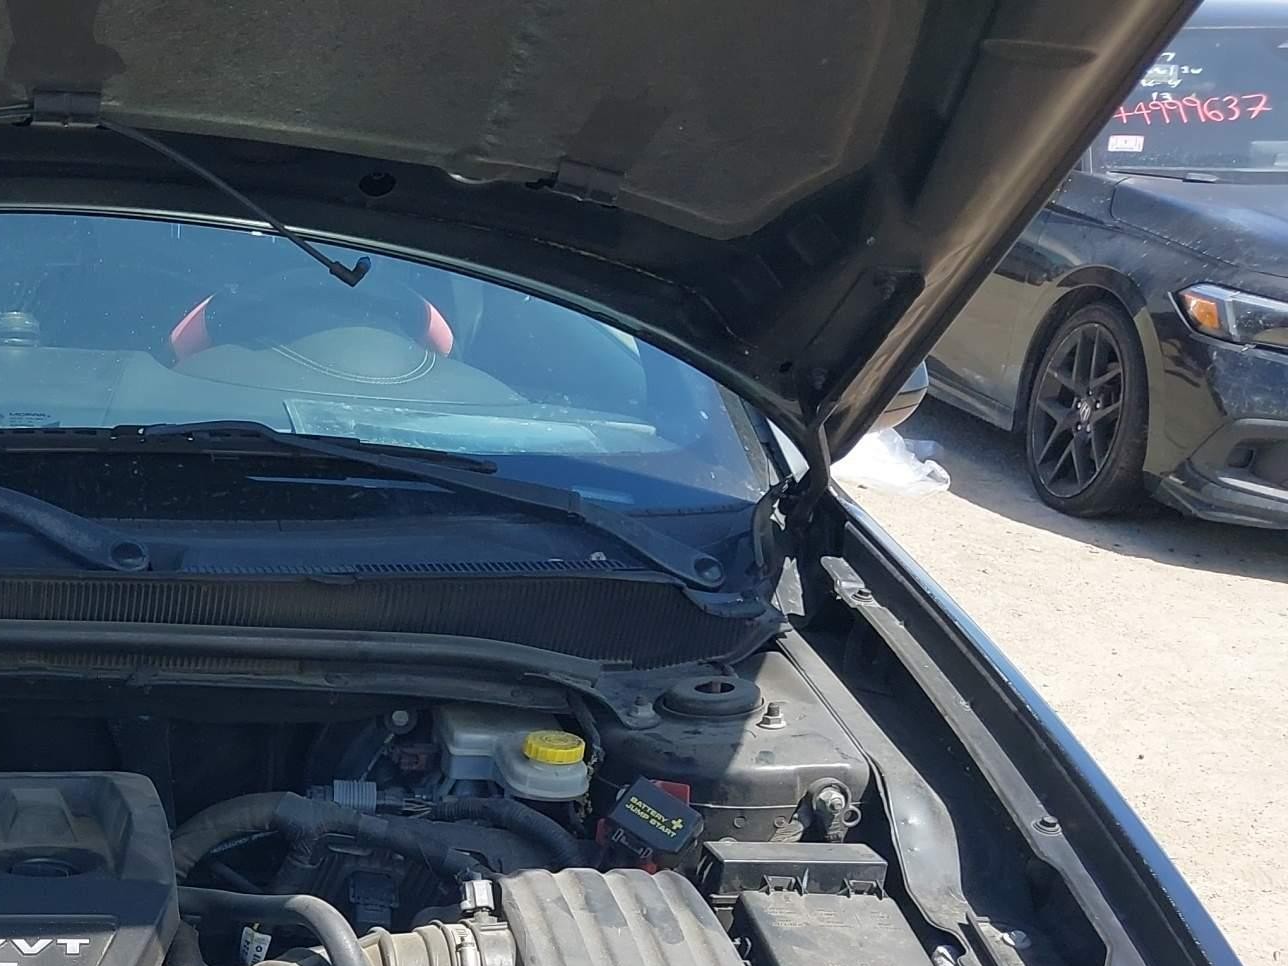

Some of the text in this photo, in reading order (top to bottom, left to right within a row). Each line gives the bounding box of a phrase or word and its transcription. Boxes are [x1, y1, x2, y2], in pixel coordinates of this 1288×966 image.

[625, 803, 677, 838] JUMP START
[630, 796, 668, 822] BATTERY
